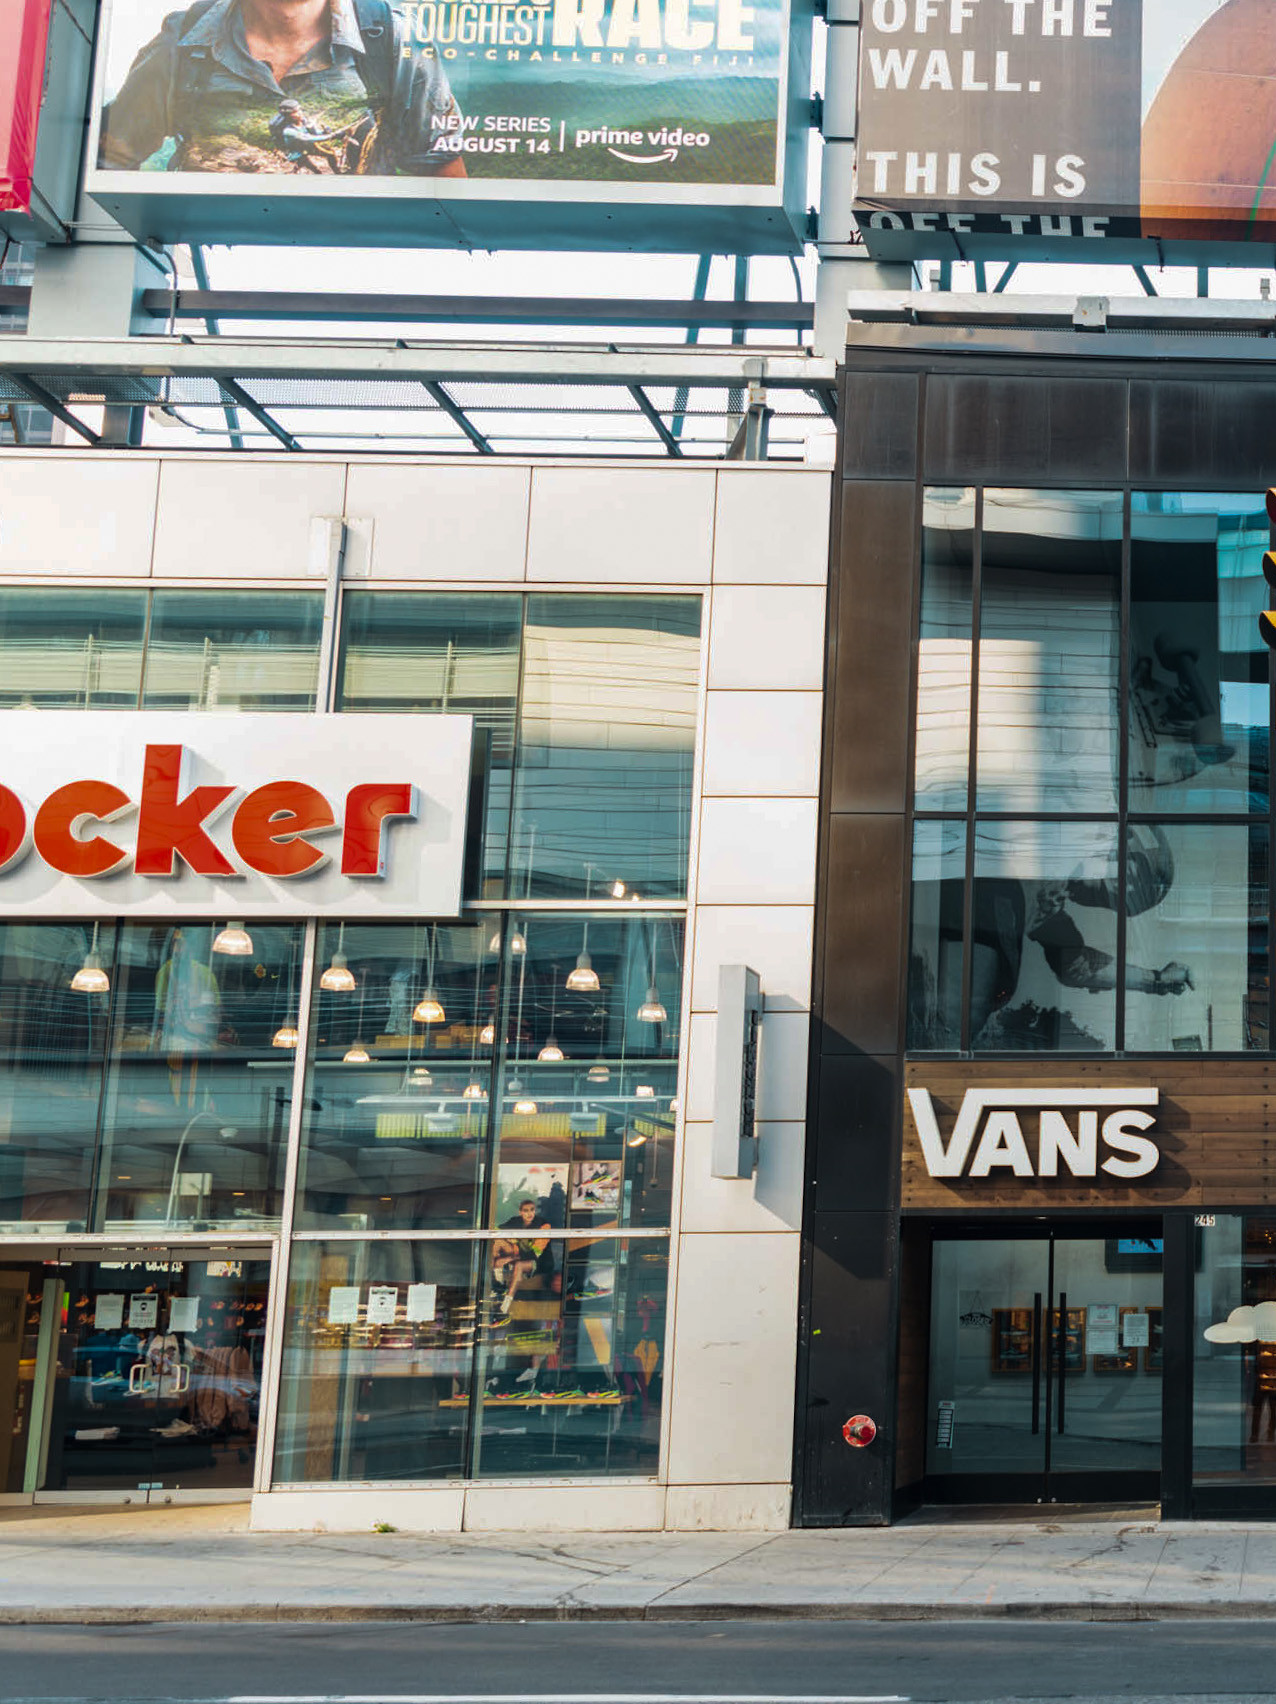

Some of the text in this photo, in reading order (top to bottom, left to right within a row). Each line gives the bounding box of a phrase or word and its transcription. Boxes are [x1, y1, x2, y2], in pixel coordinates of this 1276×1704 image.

[400, 0, 755, 50] TOUGHEST RACE
[872, 0, 1112, 37] OFF THE
[401, 48, 668, 65] ECO-CHALLENGE
[868, 48, 1041, 92] WALL.
[431, 116, 551, 133] NEW SERIES
[575, 128, 710, 149] prime video
[434, 138, 551, 154] AUGUST 14
[866, 151, 1086, 198] THIS IS
[0, 744, 412, 878] cker
[907, 1087, 1160, 1178] VANS
[1194, 1213, 1215, 1226] 245
